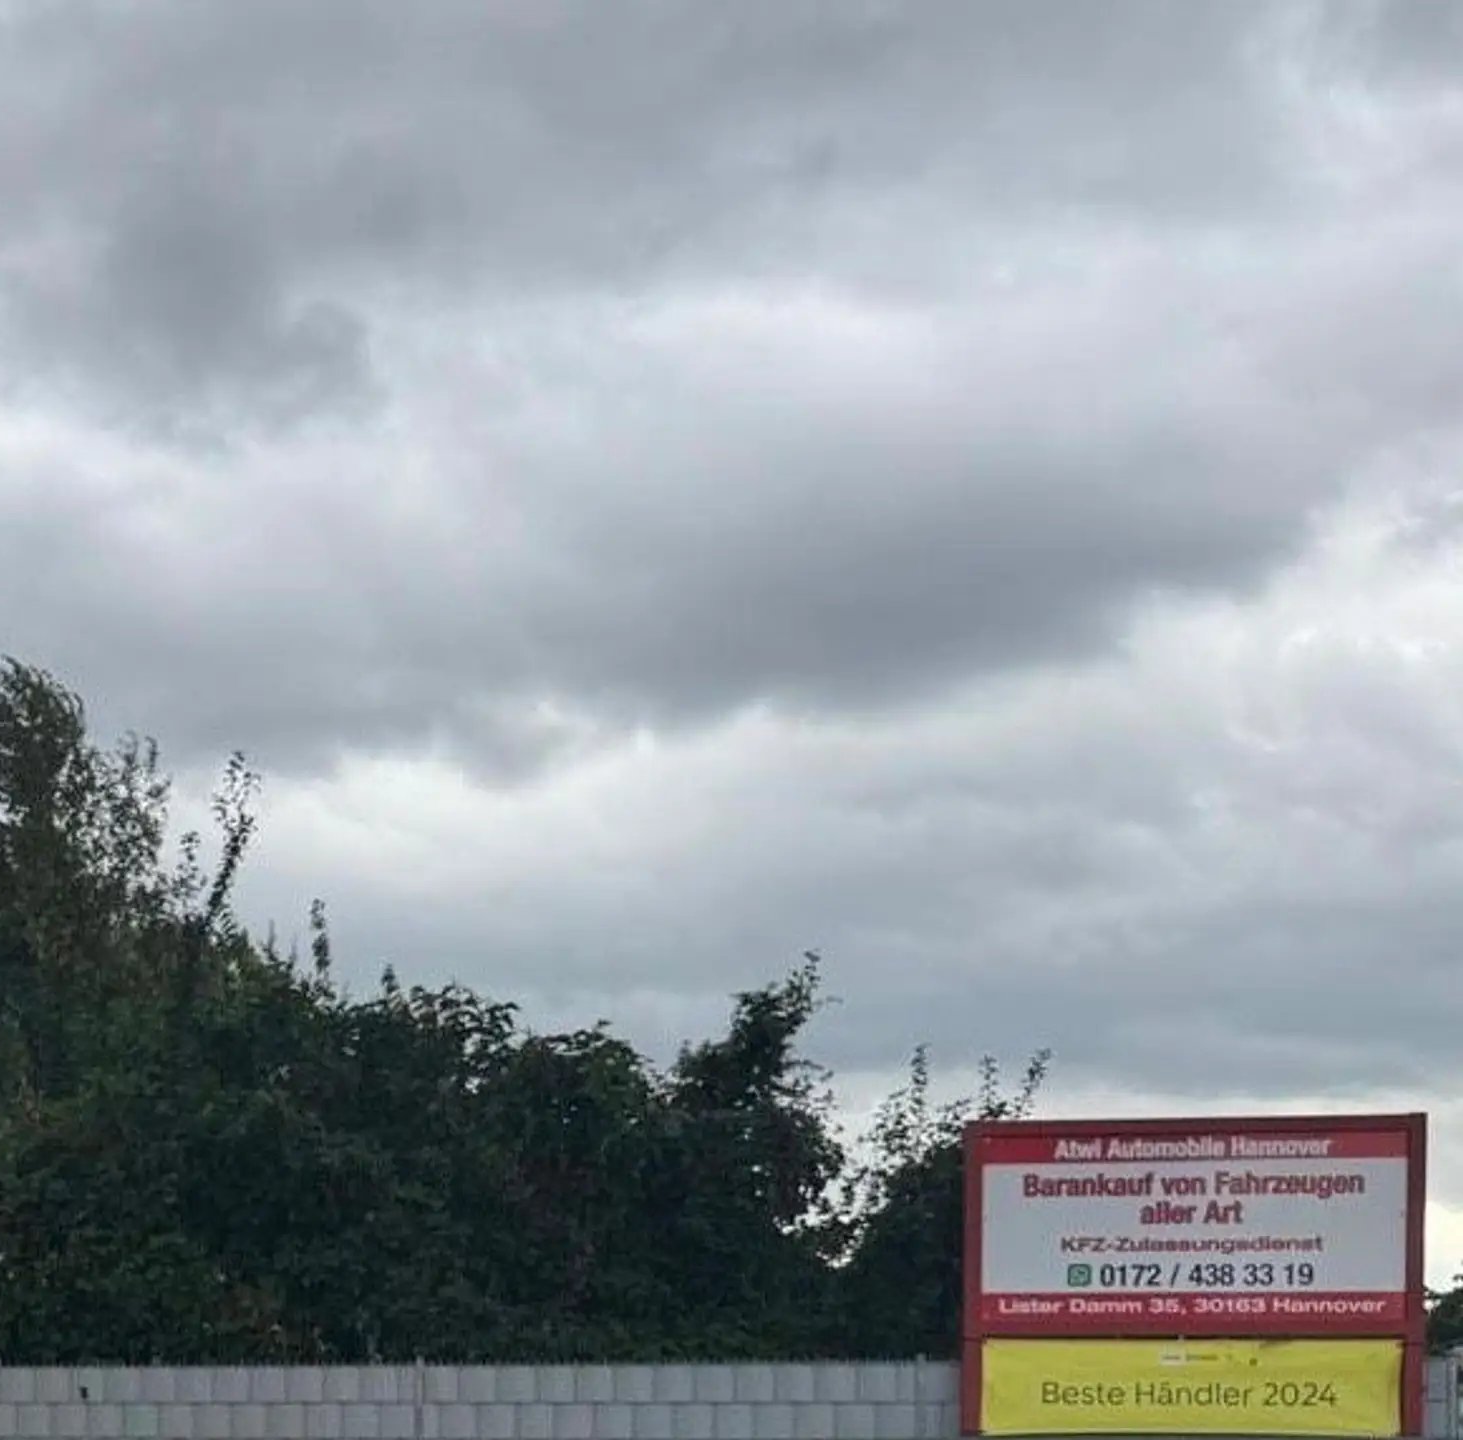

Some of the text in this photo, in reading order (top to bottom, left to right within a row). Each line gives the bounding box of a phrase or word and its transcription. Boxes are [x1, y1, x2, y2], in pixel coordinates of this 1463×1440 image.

[1107, 1137, 1225, 1158] Automobile
[1231, 1136, 1331, 1157] Hannover
[1023, 1172, 1365, 1199] Barankauf von Fahrzeugen
[1140, 1201, 1244, 1224] aller Art
[1061, 1236, 1324, 1255] KFZ-Zulassungsdienst
[1100, 1263, 1314, 1286] 0172 / 438 33 19
[998, 1298, 1062, 1314] Lister
[1070, 1298, 1143, 1314] Damm
[1195, 1298, 1266, 1313] 30163
[1273, 1298, 1386, 1313] Hannover
[1042, 1381, 1337, 1406] Beste Händler 2024
